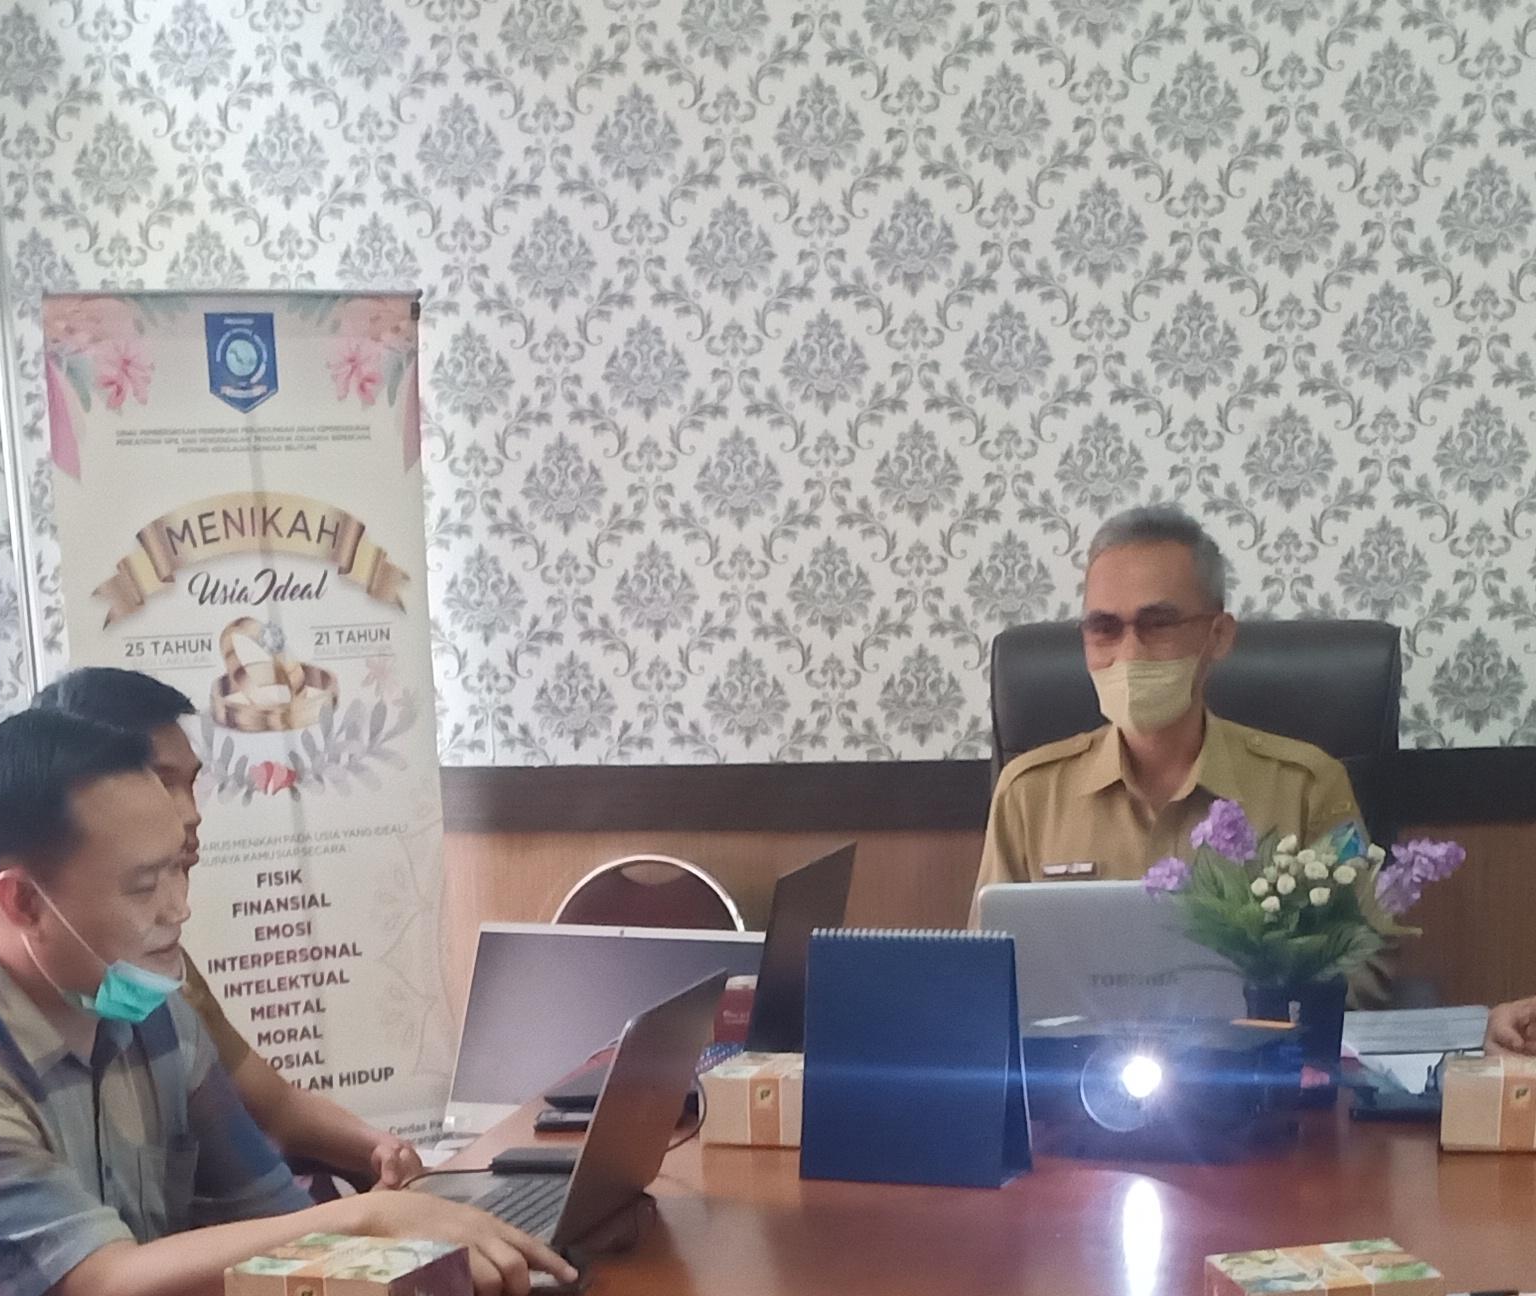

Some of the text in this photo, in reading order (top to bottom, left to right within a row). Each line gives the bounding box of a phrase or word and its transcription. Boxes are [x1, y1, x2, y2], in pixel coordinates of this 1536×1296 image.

[166, 505, 342, 557] MENIKAH
[124, 638, 213, 657] 25 TAHUN
[313, 627, 391, 647] 21 TAHUN
[256, 868, 303, 889] FISIK
[231, 893, 332, 918] FINANSIAL
[254, 921, 313, 942] EMOSI
[207, 942, 363, 976] INTERPERSONAL
[223, 969, 350, 999] INTELEKTUAL
[250, 997, 327, 1022] MENTAL
[257, 1024, 324, 1047] MORAL
[265, 1050, 326, 1073] OSIAL
[339, 1066, 395, 1088] HIDUP
